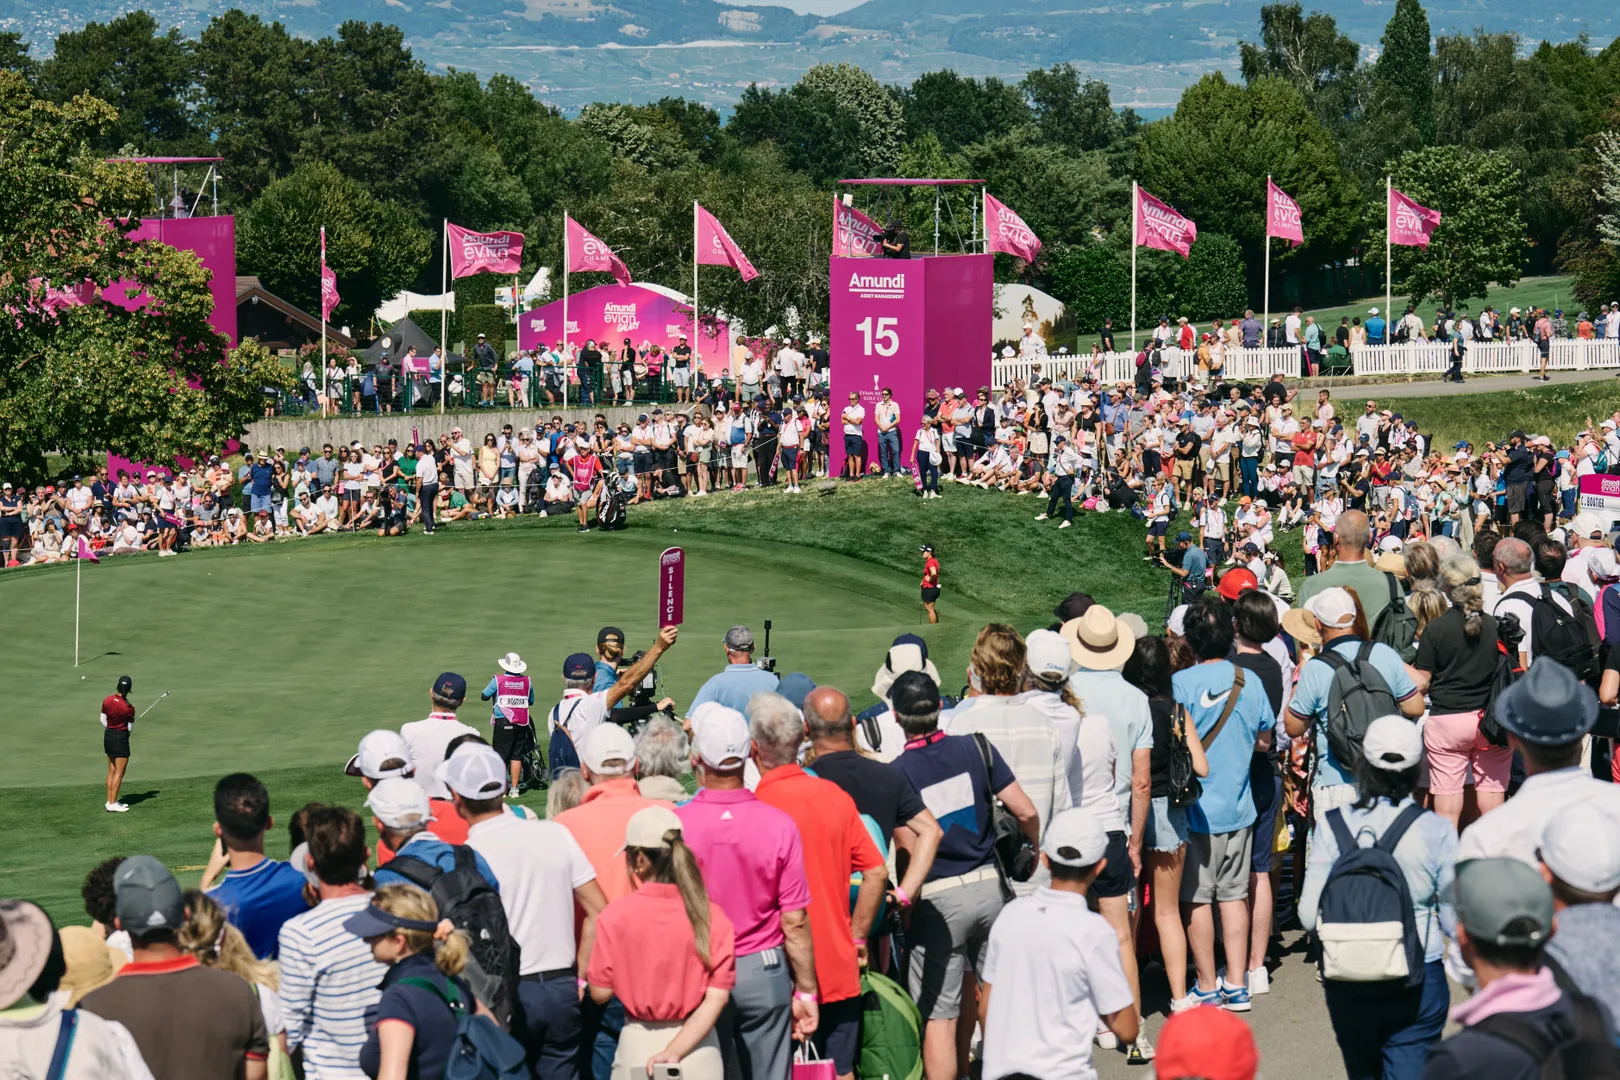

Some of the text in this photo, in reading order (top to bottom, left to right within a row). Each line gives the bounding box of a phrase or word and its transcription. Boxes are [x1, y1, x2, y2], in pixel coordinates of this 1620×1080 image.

[849, 272, 905, 289] Amundi
[604, 302, 636, 313] Amundi
[604, 314, 636, 324] evian
[856, 316, 900, 357] 15
[666, 566, 674, 622] SILENCE
